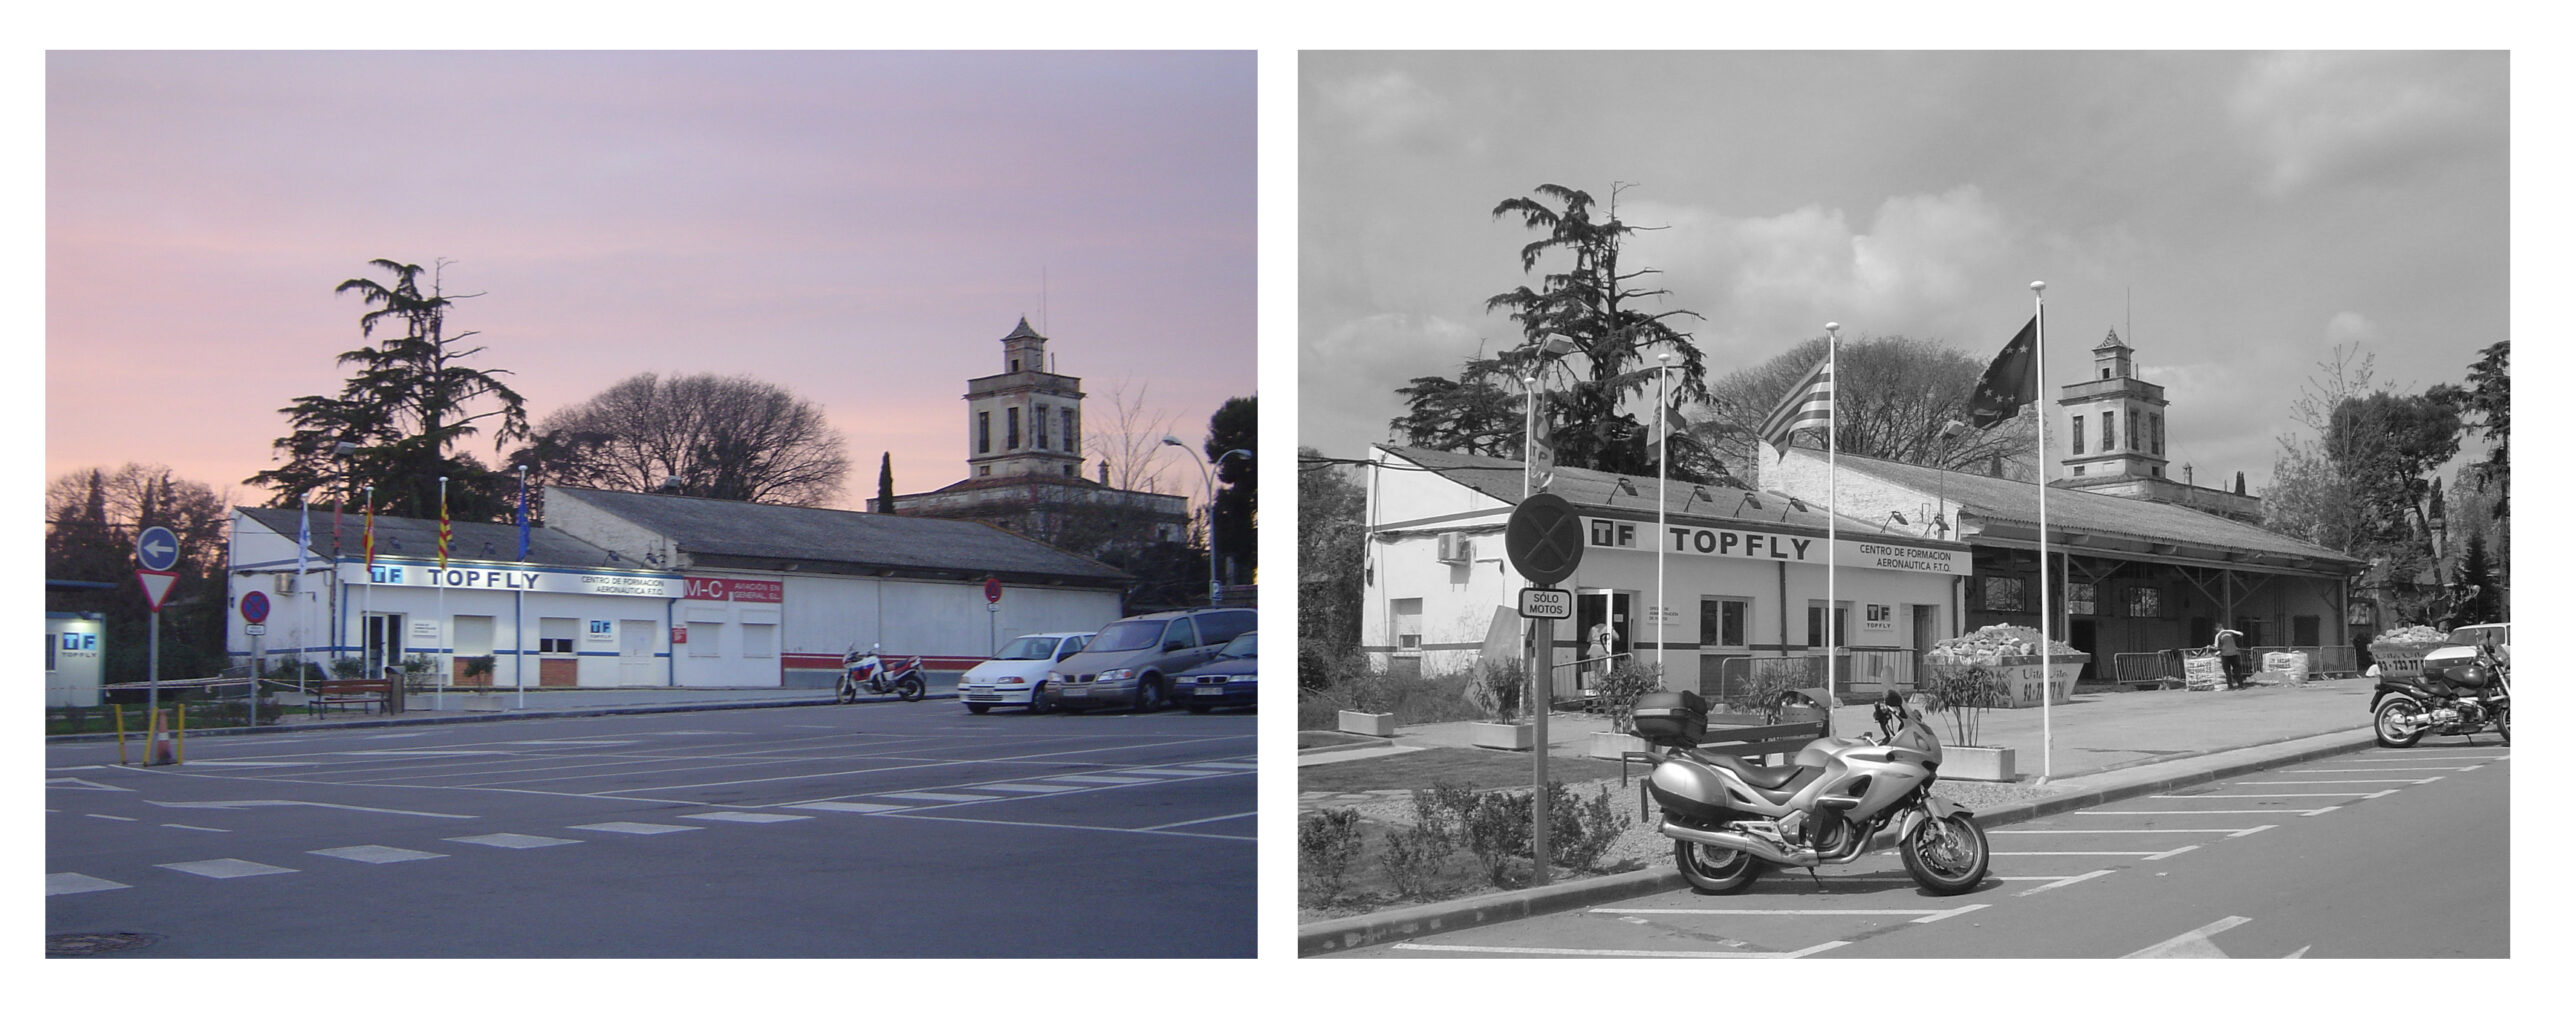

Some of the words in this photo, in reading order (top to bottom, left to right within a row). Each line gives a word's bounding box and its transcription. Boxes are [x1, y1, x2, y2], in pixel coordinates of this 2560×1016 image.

[1591, 521, 1635, 546] TF
[1669, 527, 1811, 560] TOPFLY
[1860, 544, 1892, 556] CENTRO
[1894, 548, 1904, 557] DE
[1907, 549, 1951, 561] FORMACION
[1877, 558, 1931, 571] AERONAUTICA
[371, 566, 402, 583] TF
[428, 569, 540, 589] TOPFLY
[581, 576, 610, 585] CENTRO
[612, 577, 622, 585] DE
[623, 578, 665, 587] FORMACION
[596, 586, 645, 595] AERONAUTICA
[1533, 592, 1559, 603] SÓLO
[1529, 604, 1563, 614] MOTOS
[1867, 604, 1891, 621] TF
[591, 621, 611, 633] TF
[63, 632, 97, 650] TF
